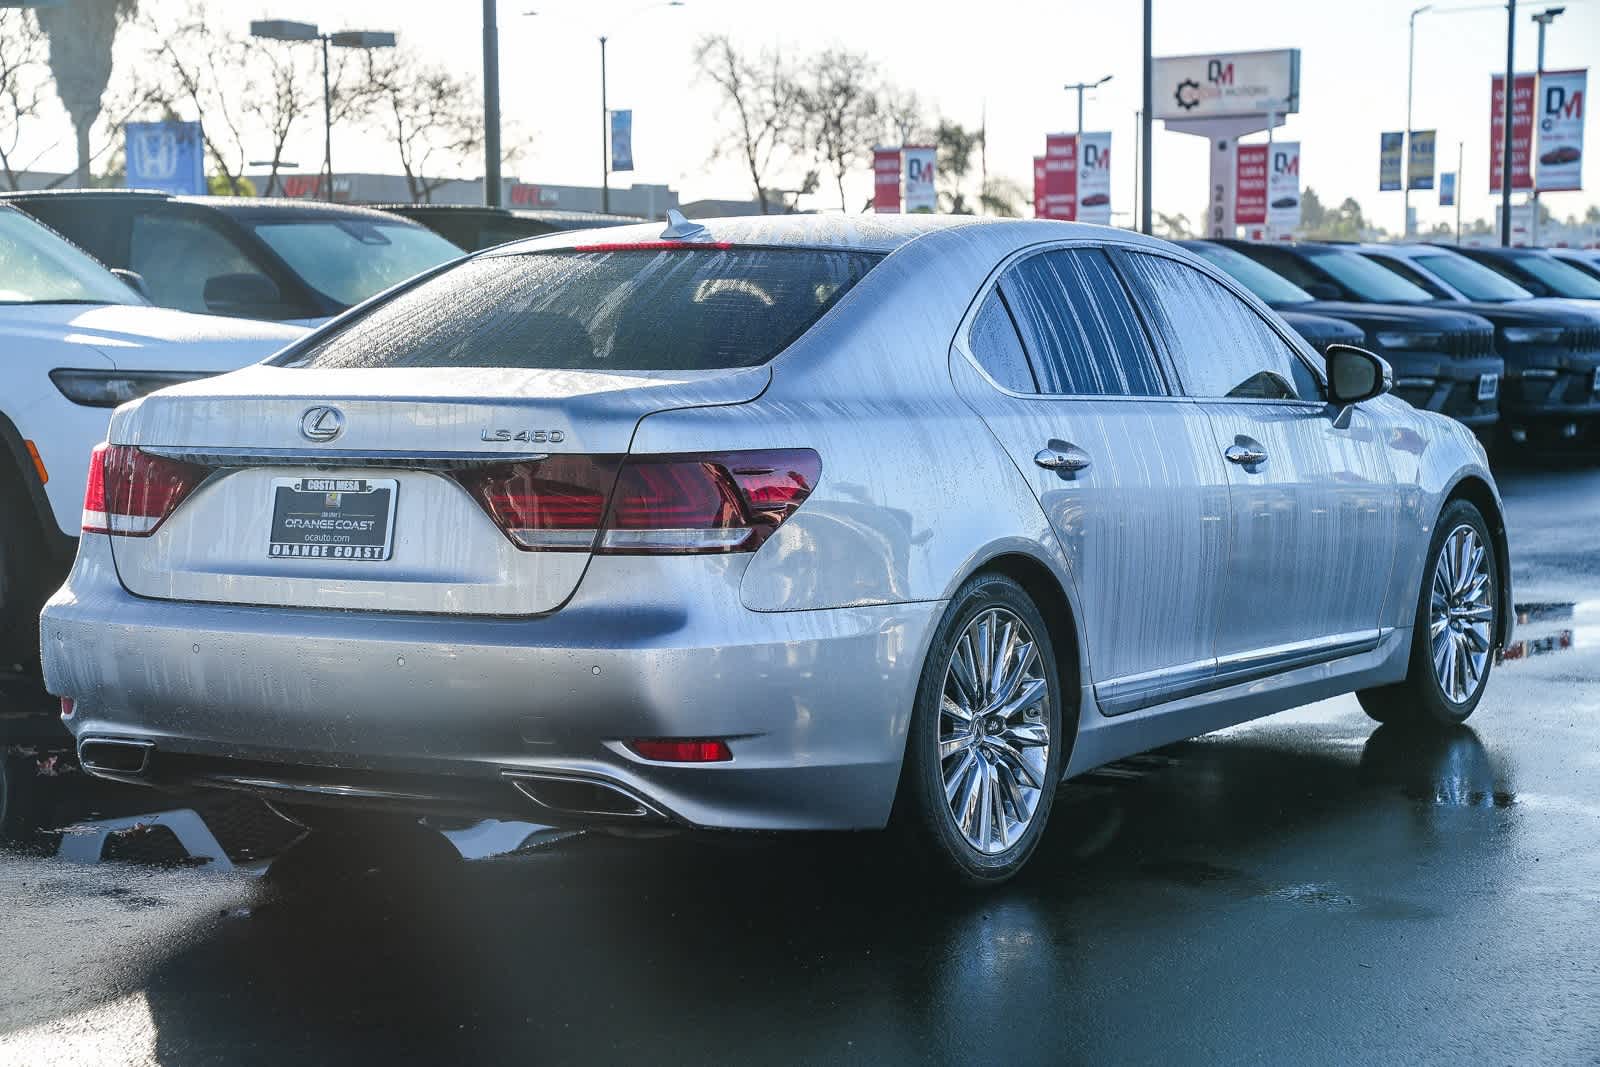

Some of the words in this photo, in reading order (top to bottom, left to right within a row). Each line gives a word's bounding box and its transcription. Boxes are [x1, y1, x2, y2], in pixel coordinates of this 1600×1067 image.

[1546, 86, 1583, 119] DM
[480, 429, 512, 442] LS
[513, 429, 565, 443] 460
[307, 480, 335, 491] COSTA
[335, 480, 360, 491] MESA
[304, 534, 351, 544] ocauto.com
[272, 544, 329, 557] ORANGE
[333, 546, 382, 559] COAST
